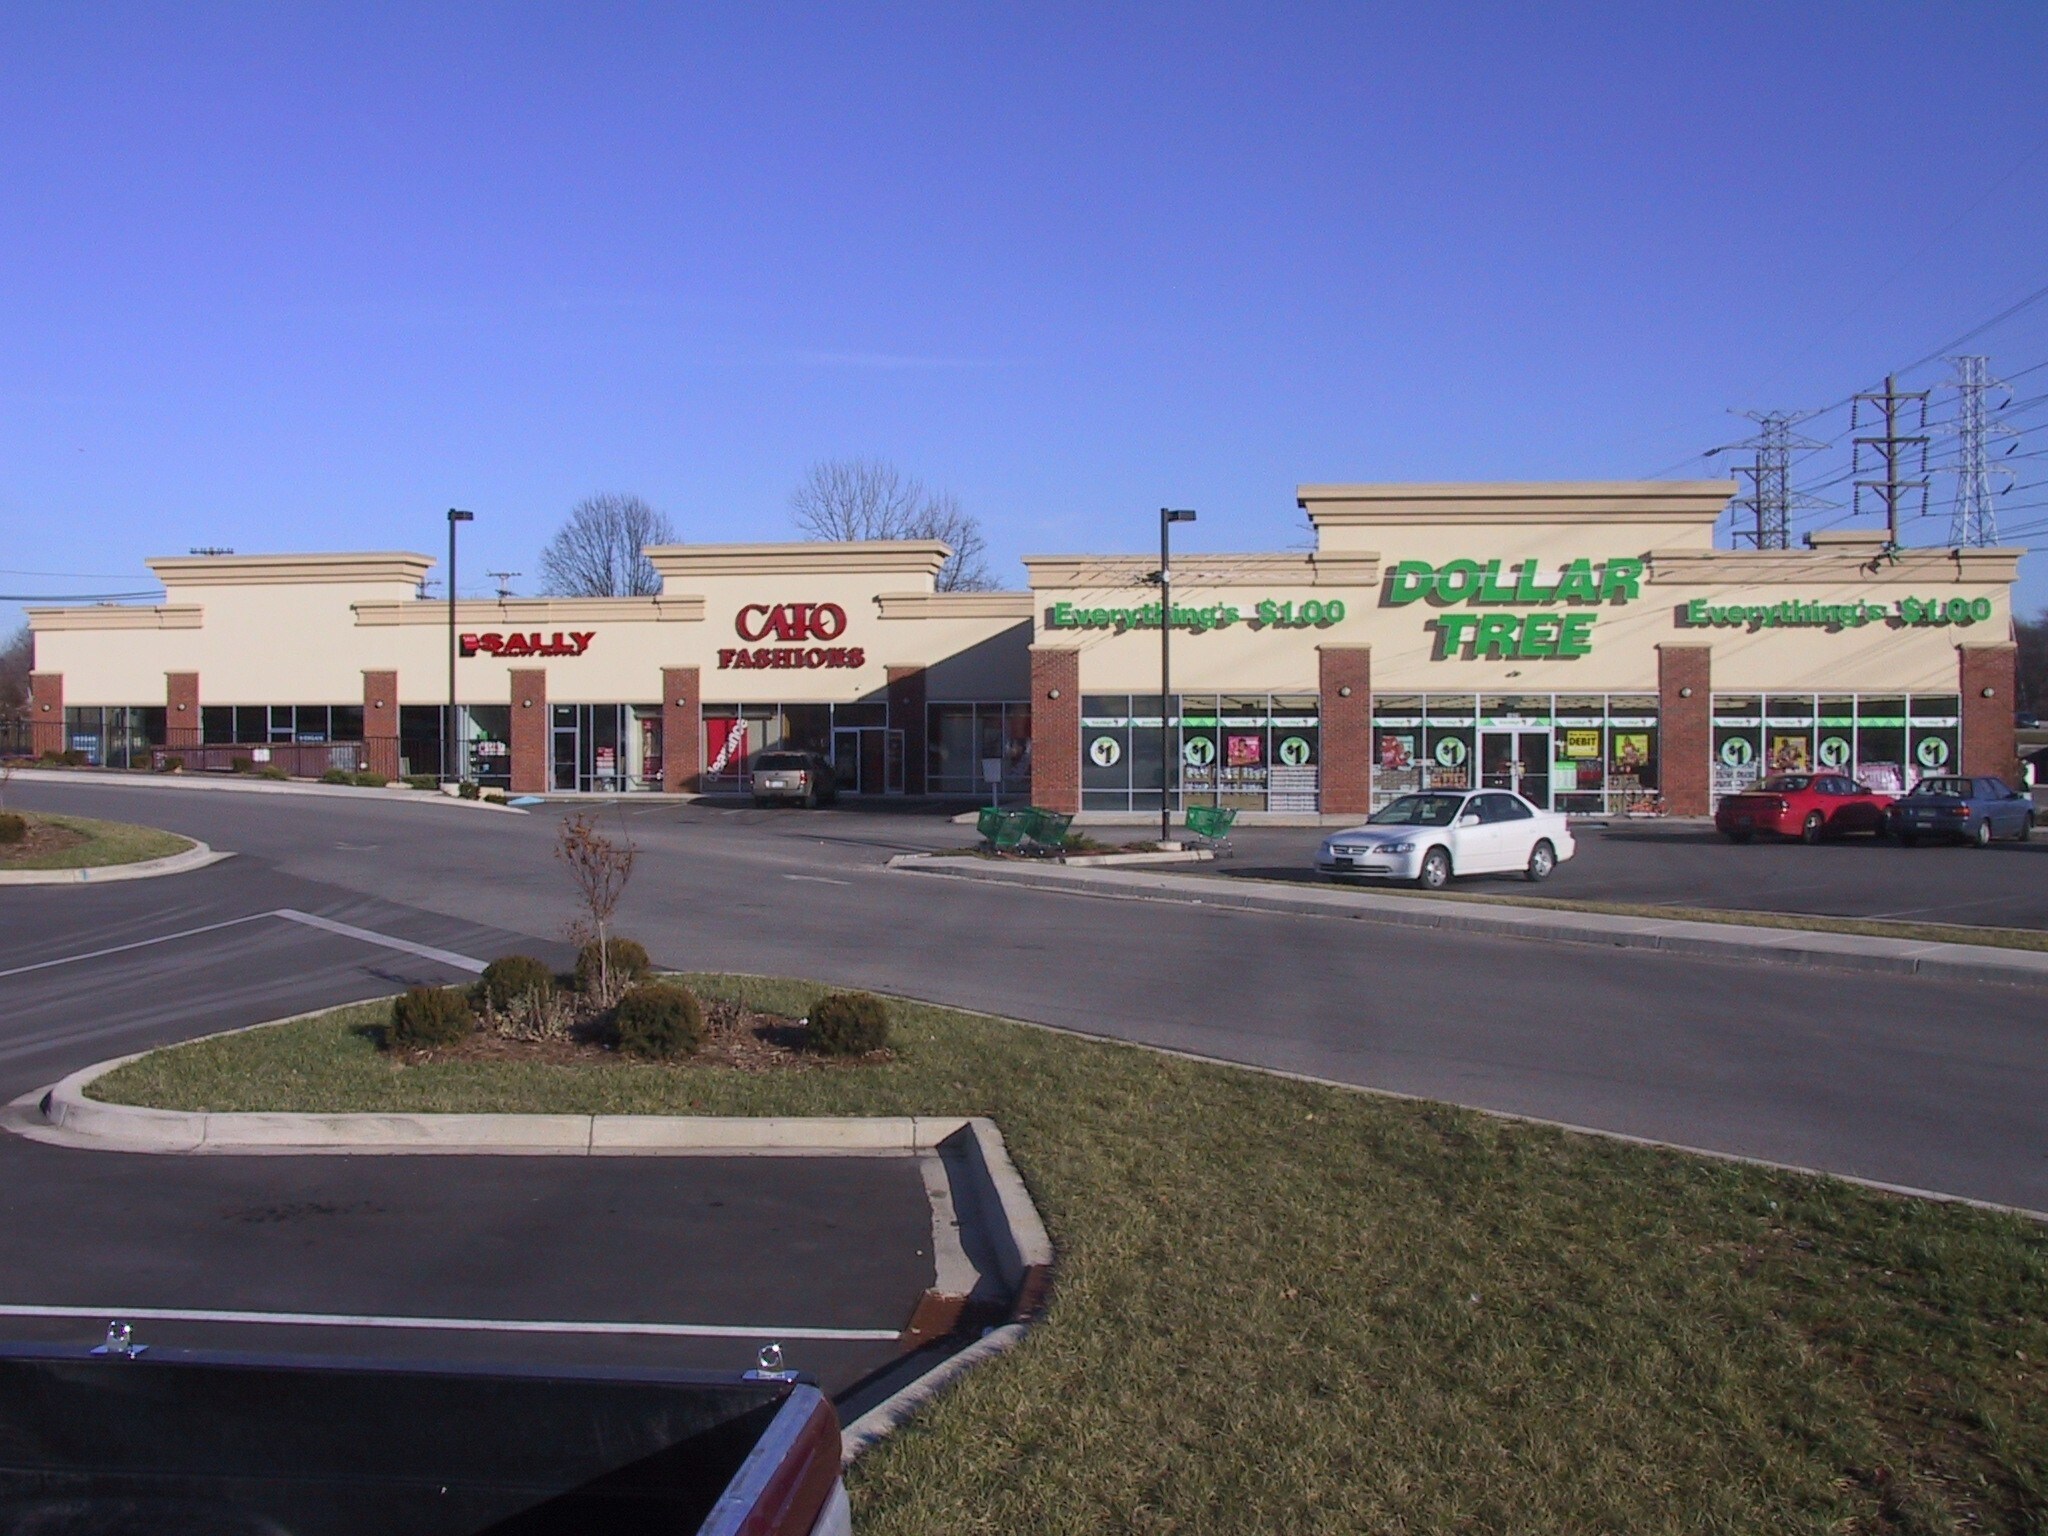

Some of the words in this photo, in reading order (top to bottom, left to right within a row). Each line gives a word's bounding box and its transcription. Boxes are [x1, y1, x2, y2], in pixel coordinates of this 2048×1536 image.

[1390, 558, 1643, 602] DOLLAR
[734, 602, 848, 642] CATO
[1258, 599, 1346, 624] $1.00
[1686, 598, 1886, 627] Everything's
[1900, 595, 1992, 623] $1.00
[479, 631, 597, 652] SALLY
[1437, 613, 1598, 656] TREE
[717, 647, 866, 670] FASHIONS
[1568, 737, 1597, 747] DEBIT
